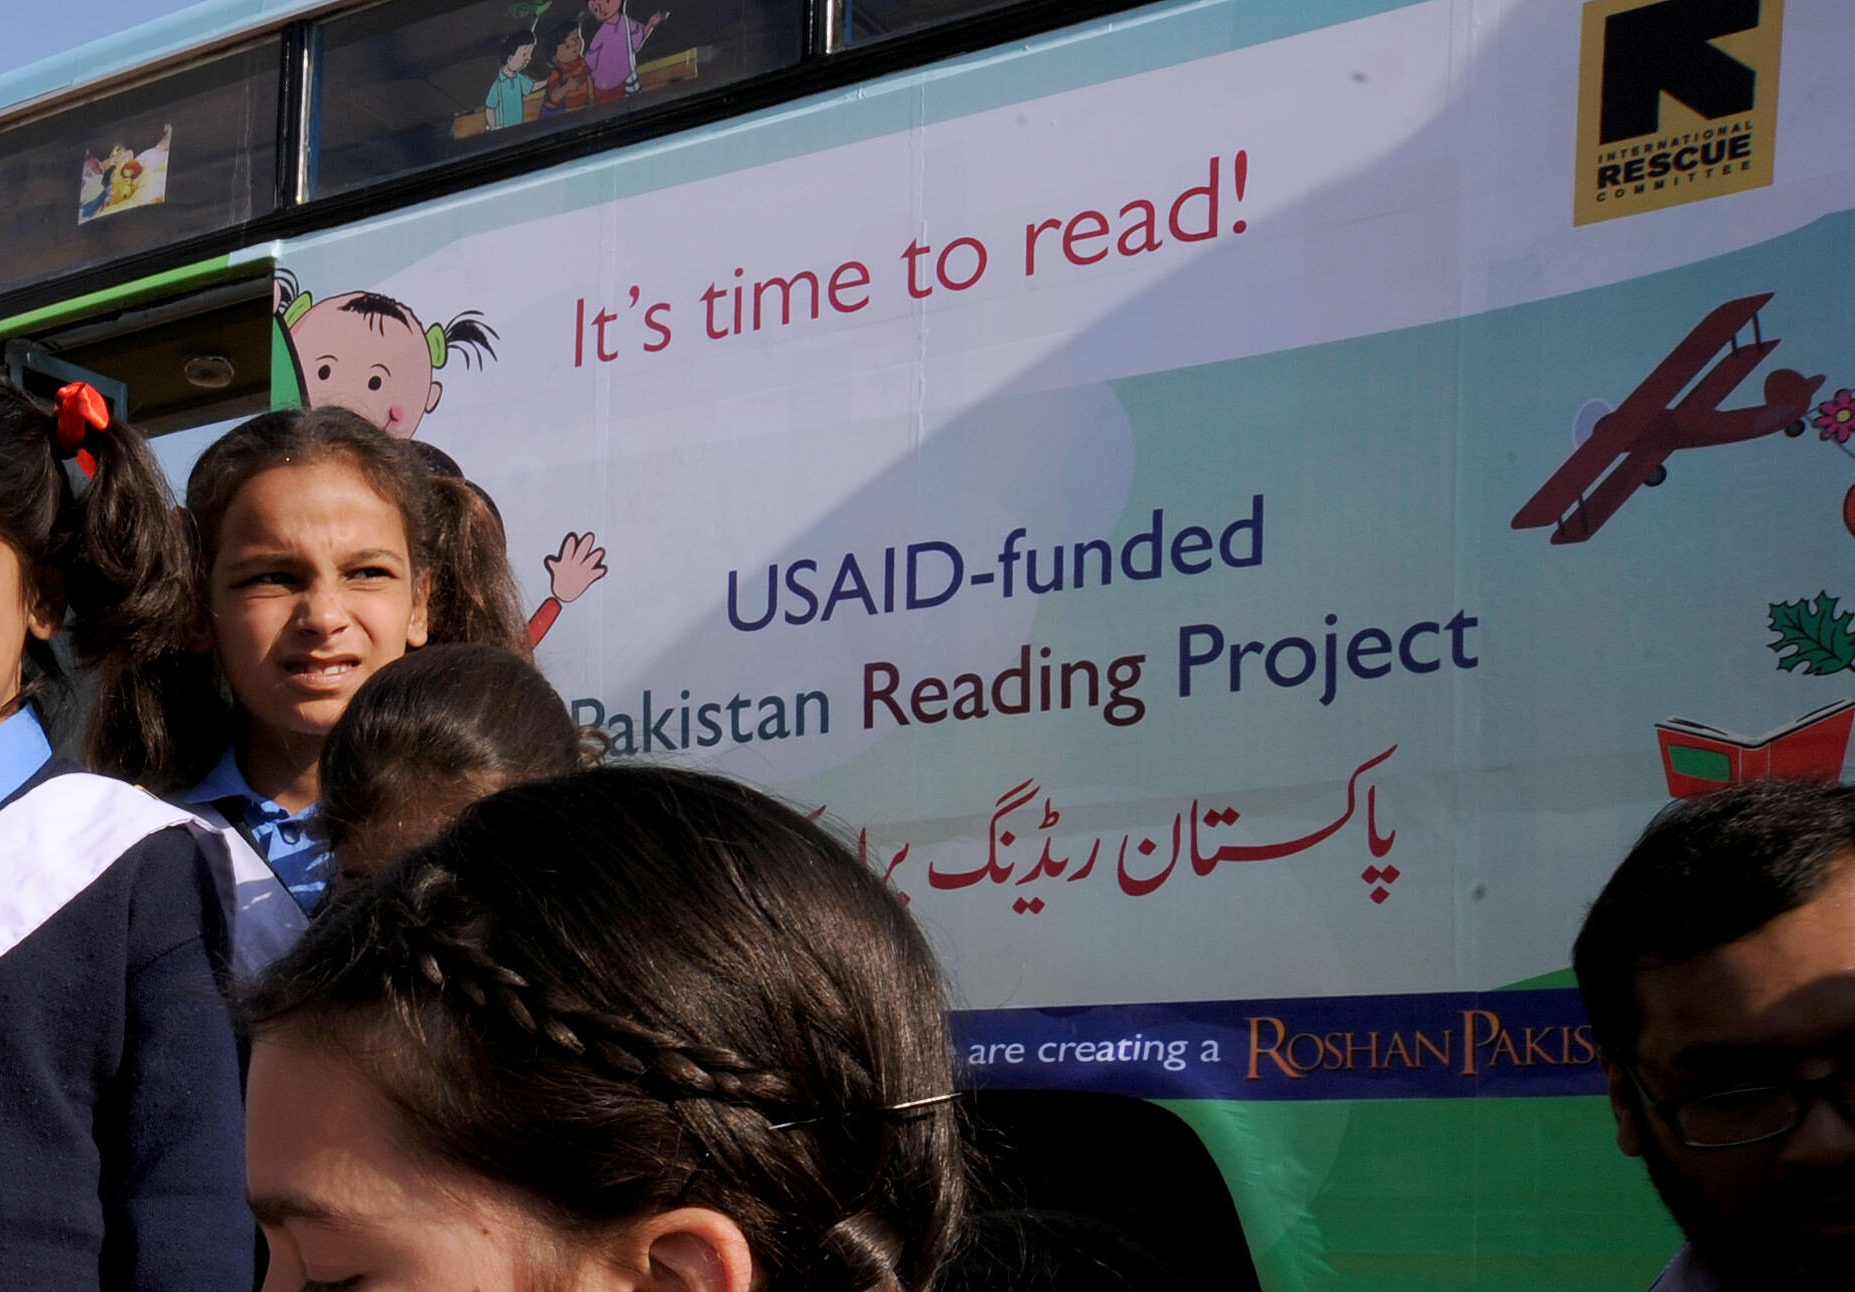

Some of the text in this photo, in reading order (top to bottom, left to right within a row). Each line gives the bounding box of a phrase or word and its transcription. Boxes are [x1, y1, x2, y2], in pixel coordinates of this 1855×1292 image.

[1596, 160, 1751, 202] COMMITTEE
[1597, 133, 1752, 190] RESCUE
[1598, 121, 1753, 164] INTERNATIONAL
[574, 149, 1248, 368] It's time to read!
[727, 493, 1264, 632] USAID-funded
[571, 608, 1479, 757] Pakistan Reading Project
[928, 779, 1100, 915] ریڈنگ
[1117, 746, 1400, 904] پاکستان
[968, 1042, 1025, 1065] are
[1038, 1033, 1189, 1071] creating
[1200, 1039, 1221, 1063] a
[1245, 1016, 1452, 1080] ROSHAN
